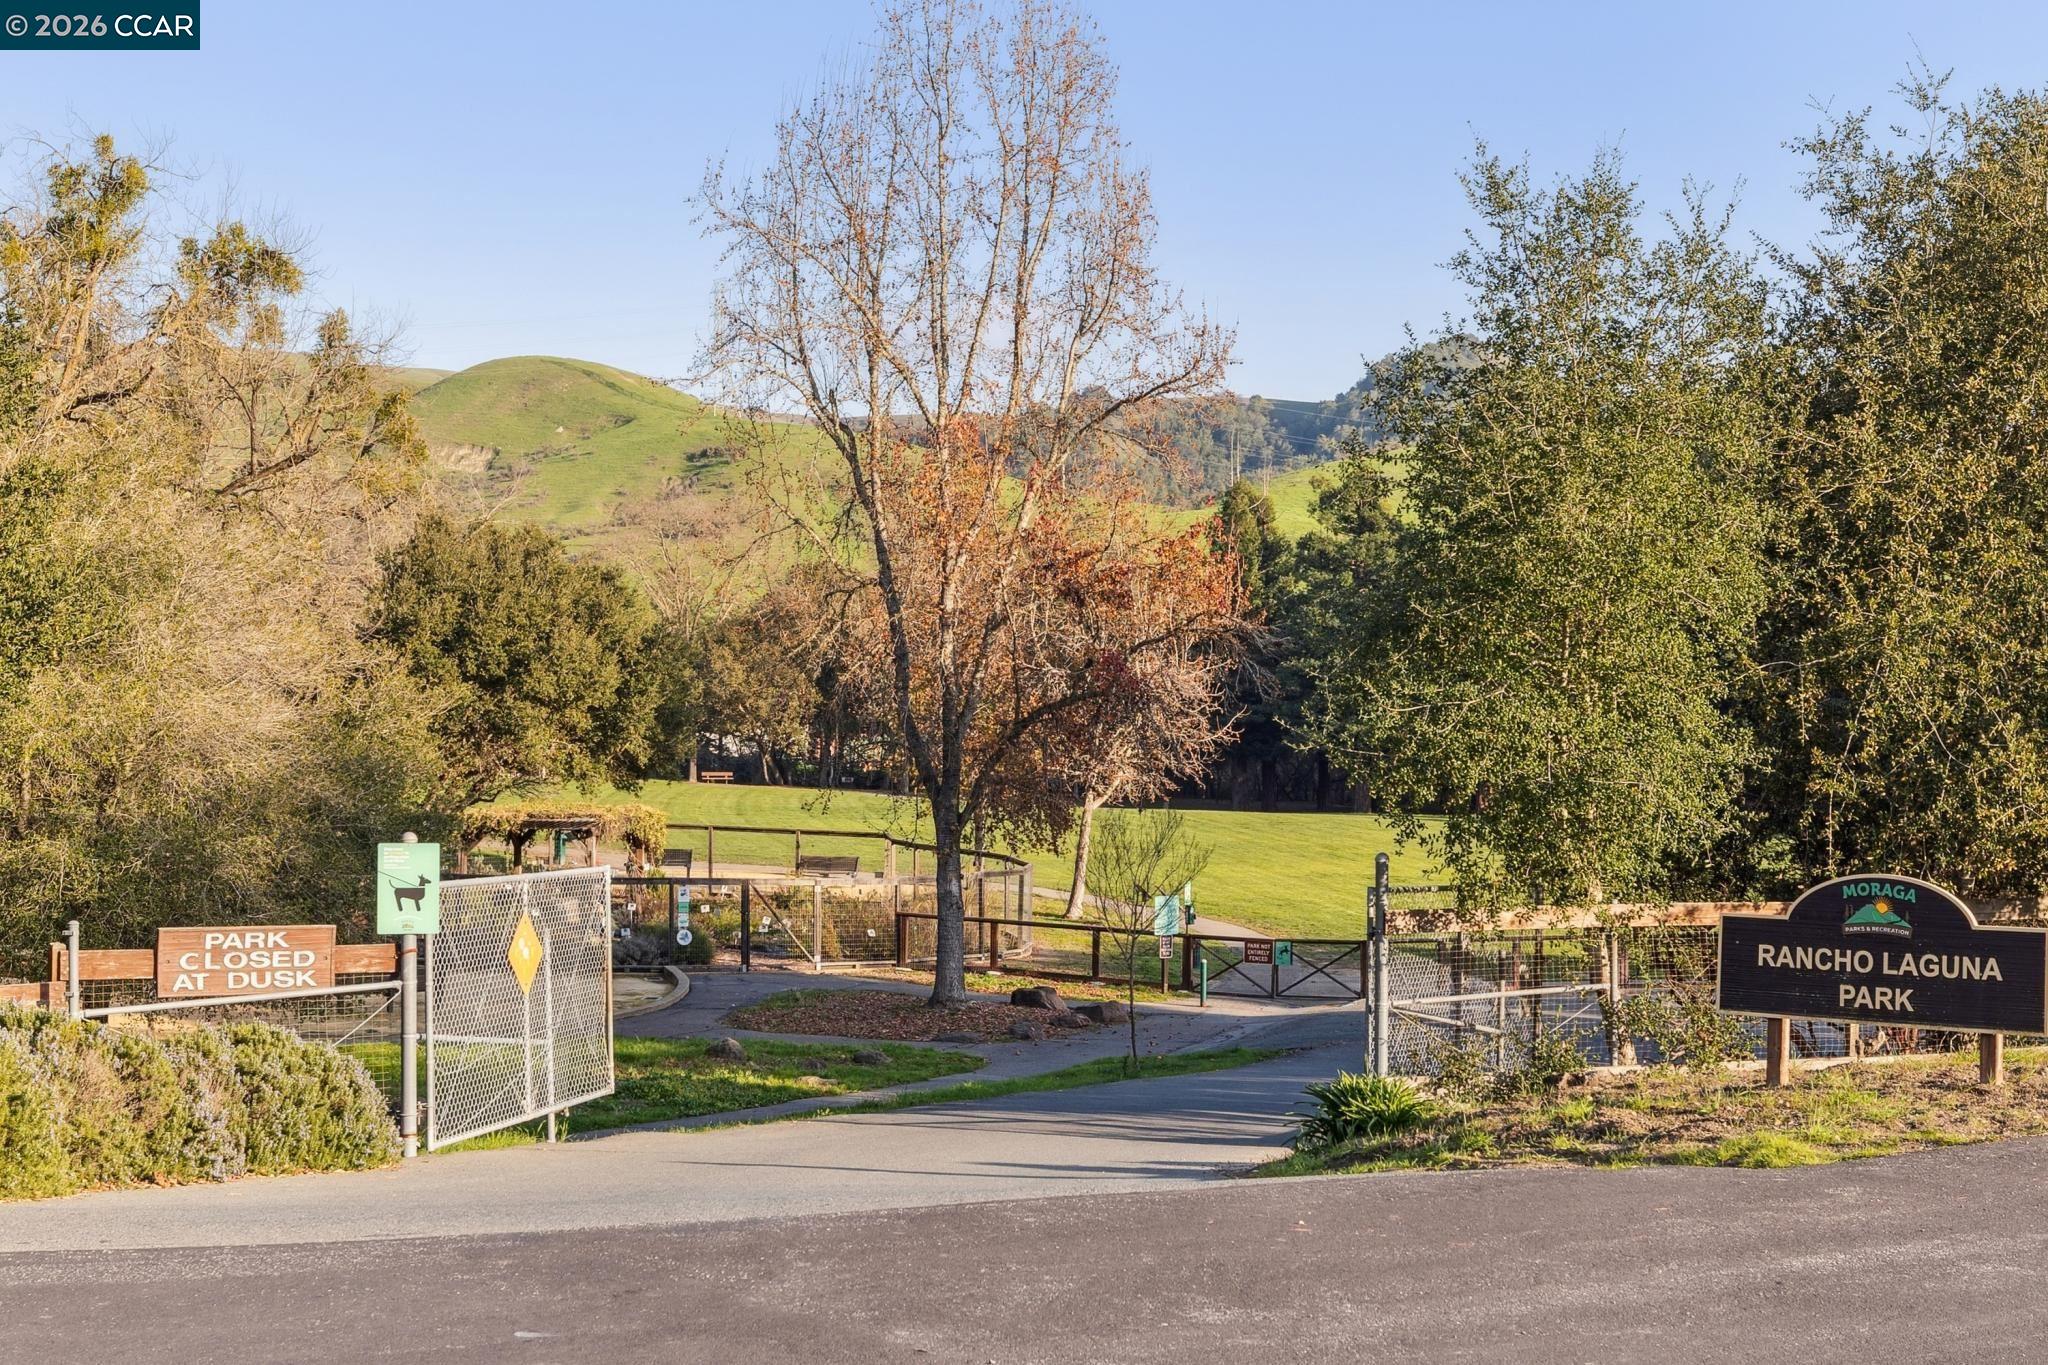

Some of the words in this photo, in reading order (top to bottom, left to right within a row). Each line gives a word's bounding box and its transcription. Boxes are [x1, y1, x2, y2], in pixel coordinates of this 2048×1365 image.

[1842, 882, 1916, 903] MORAGA
[204, 931, 290, 950] PARK
[1871, 926, 1910, 936] RECREATION
[179, 950, 316, 971] CLOSED
[1757, 944, 1874, 974] RANCHO
[1882, 951, 2003, 982] LAGUNA
[172, 973, 209, 993] AT
[227, 969, 318, 990] DUSK
[1839, 984, 1914, 1012] PARK
